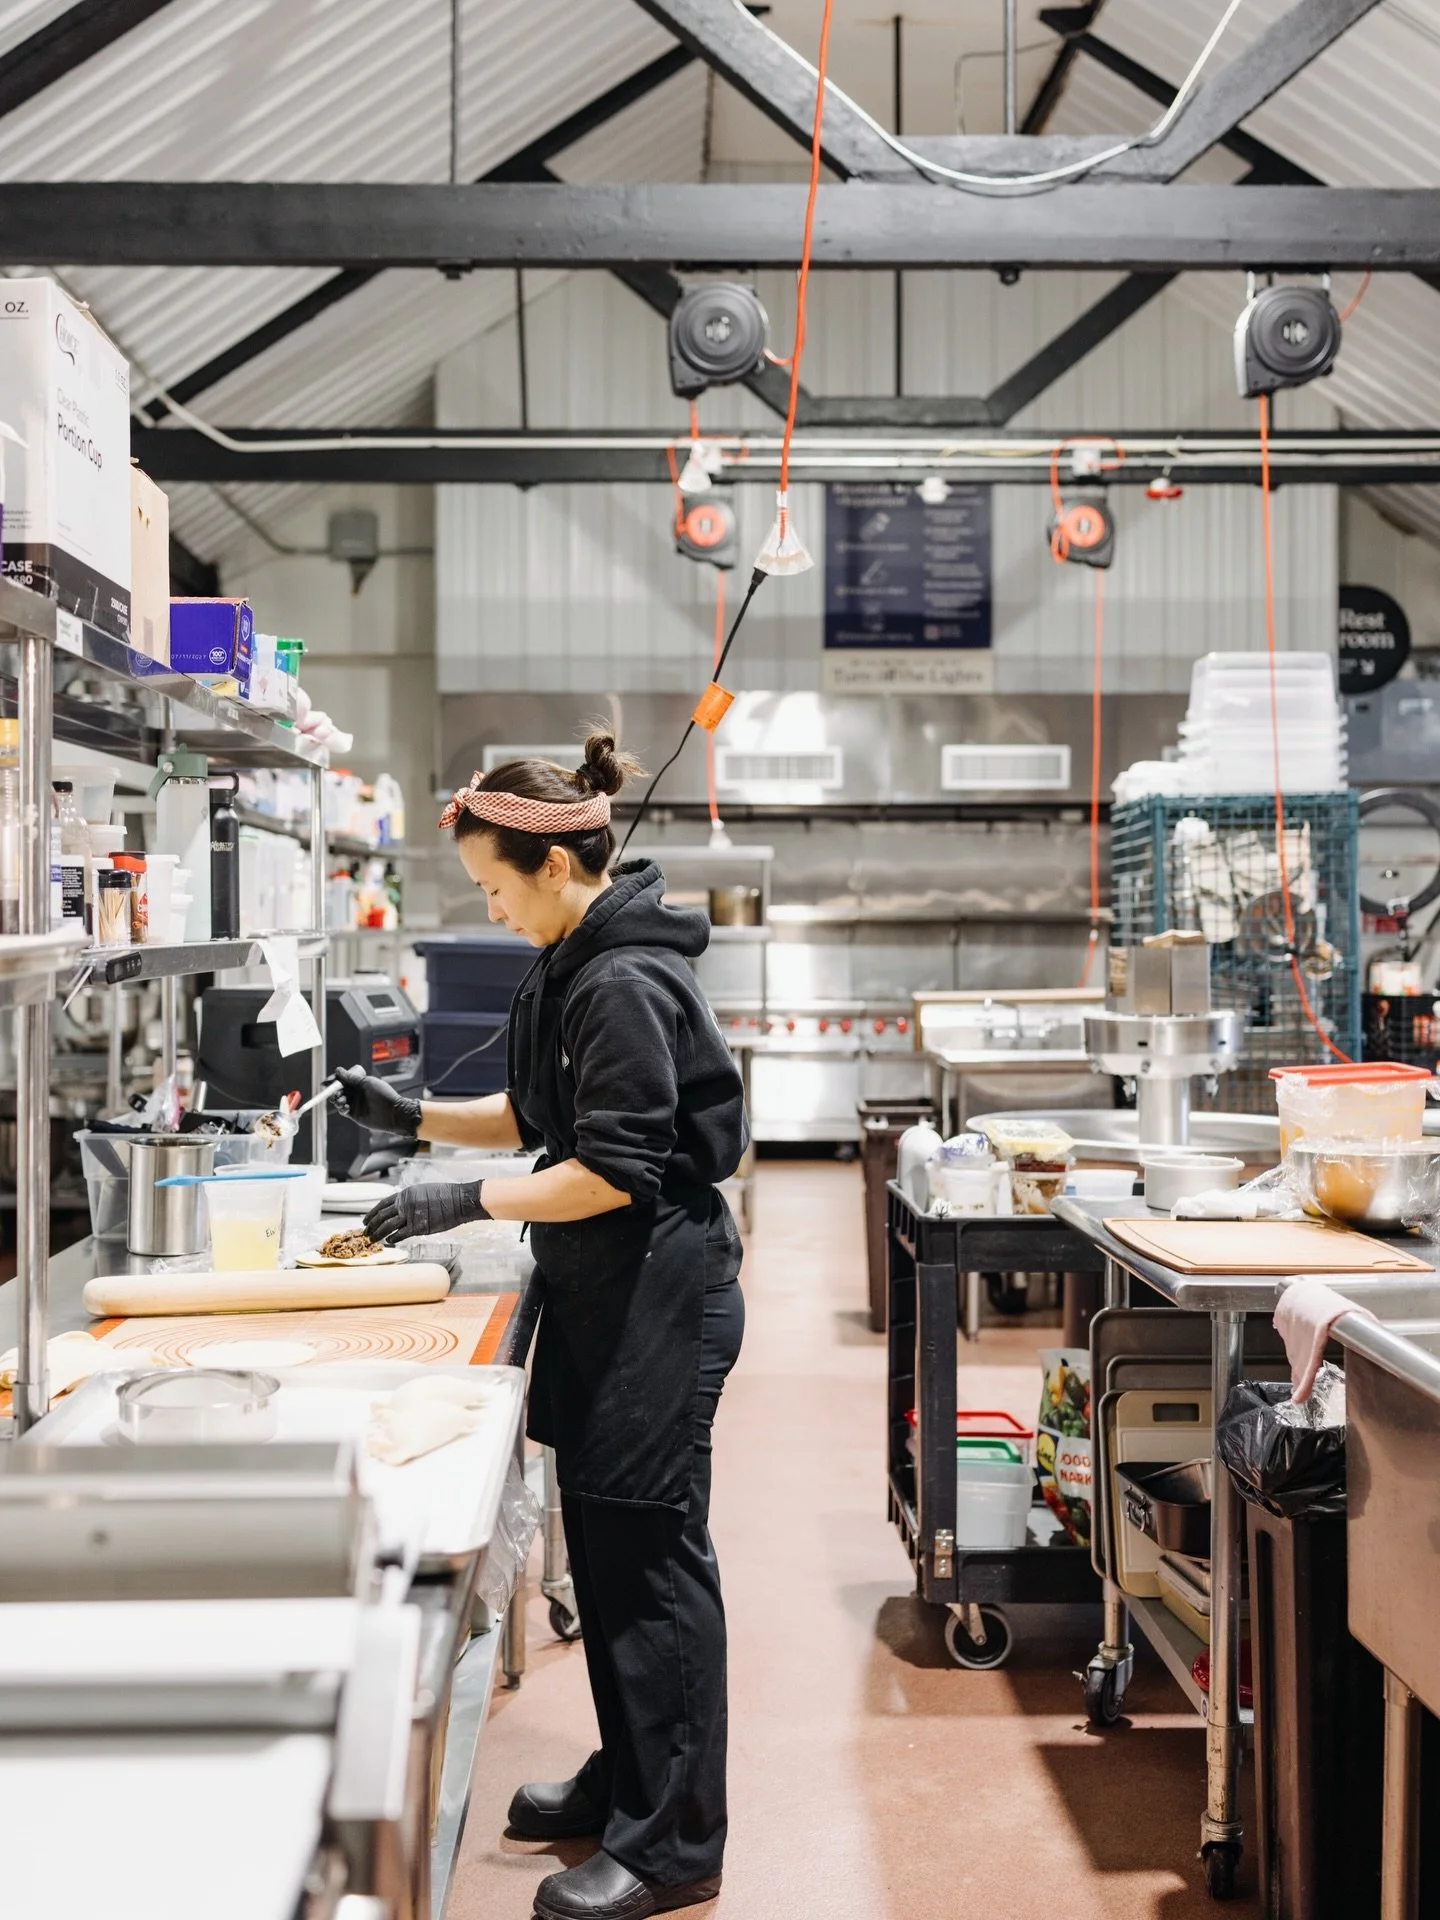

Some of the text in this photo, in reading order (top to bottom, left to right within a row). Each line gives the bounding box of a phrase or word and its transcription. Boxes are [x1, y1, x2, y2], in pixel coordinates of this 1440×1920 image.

[4, 301, 29, 313] OZ.
[57, 412, 103, 473] Portion Cup
